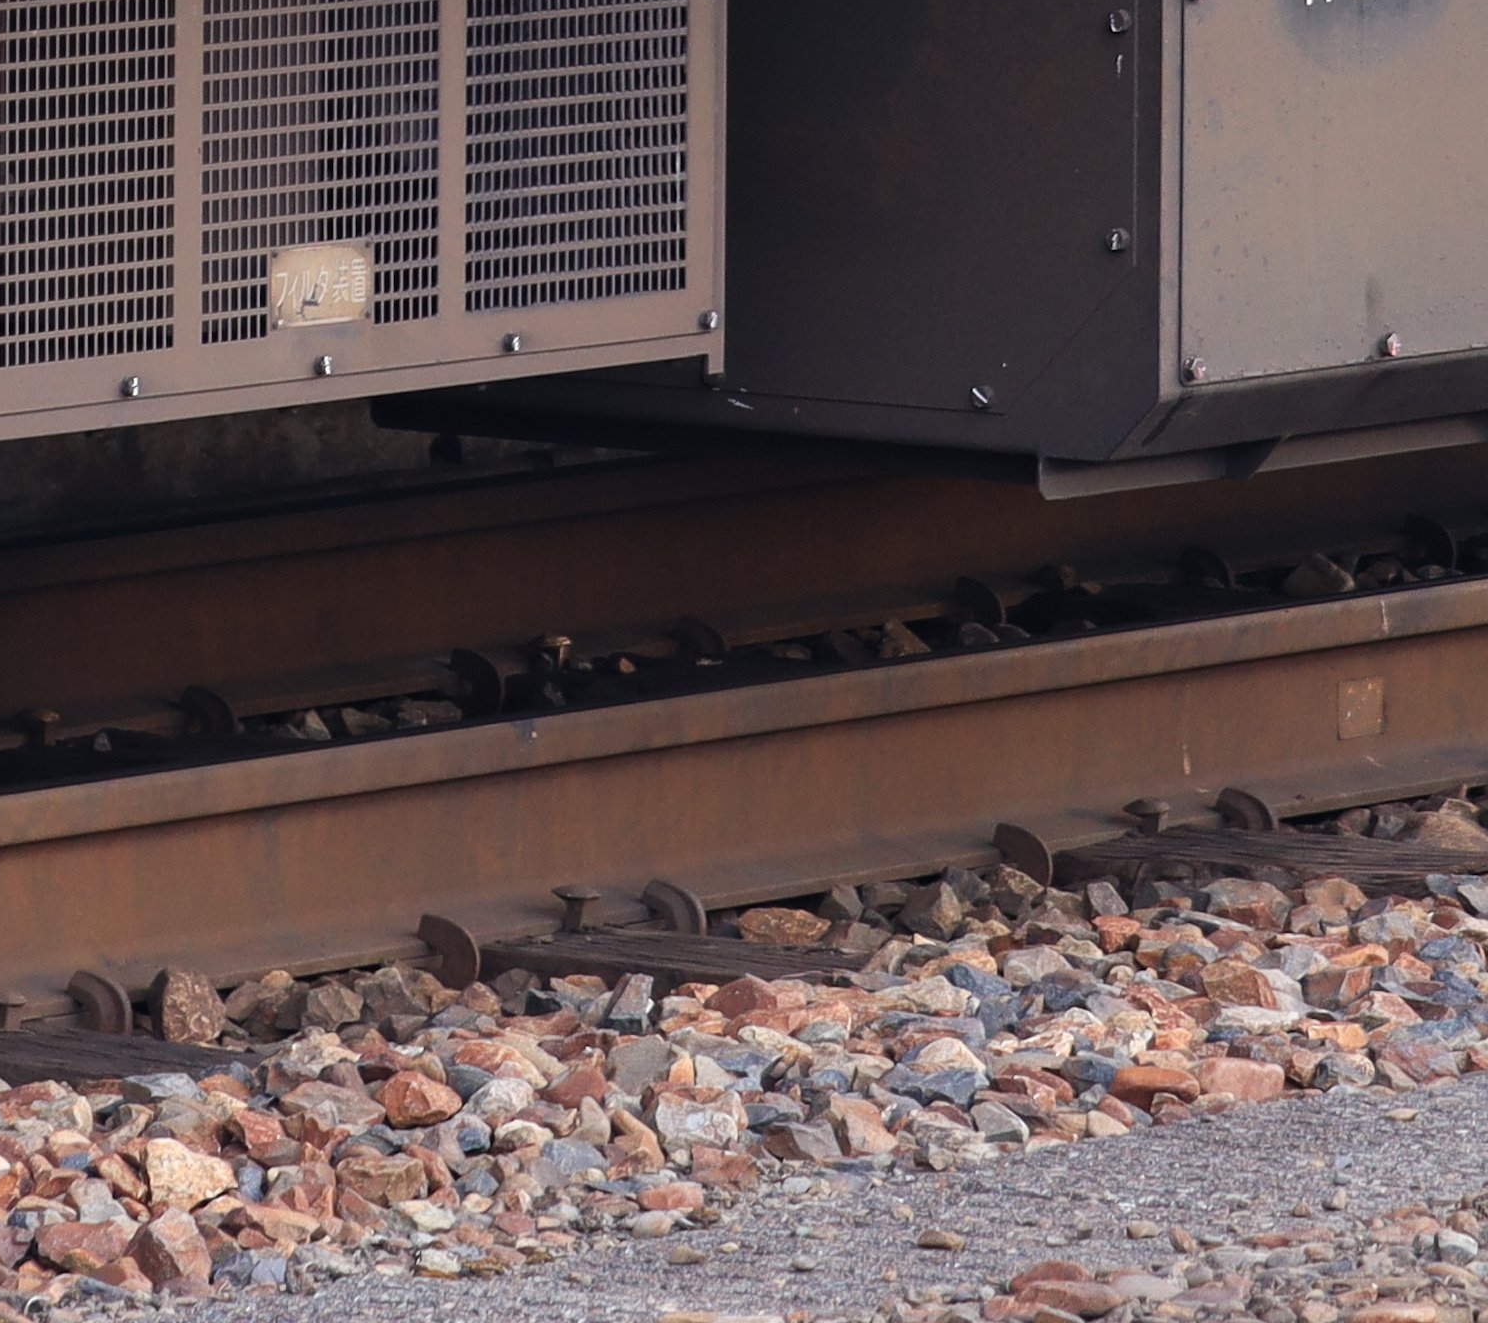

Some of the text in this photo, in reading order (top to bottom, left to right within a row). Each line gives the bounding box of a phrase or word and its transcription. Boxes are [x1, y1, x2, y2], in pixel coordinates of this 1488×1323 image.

[276, 257, 368, 309] フィルタ装置
